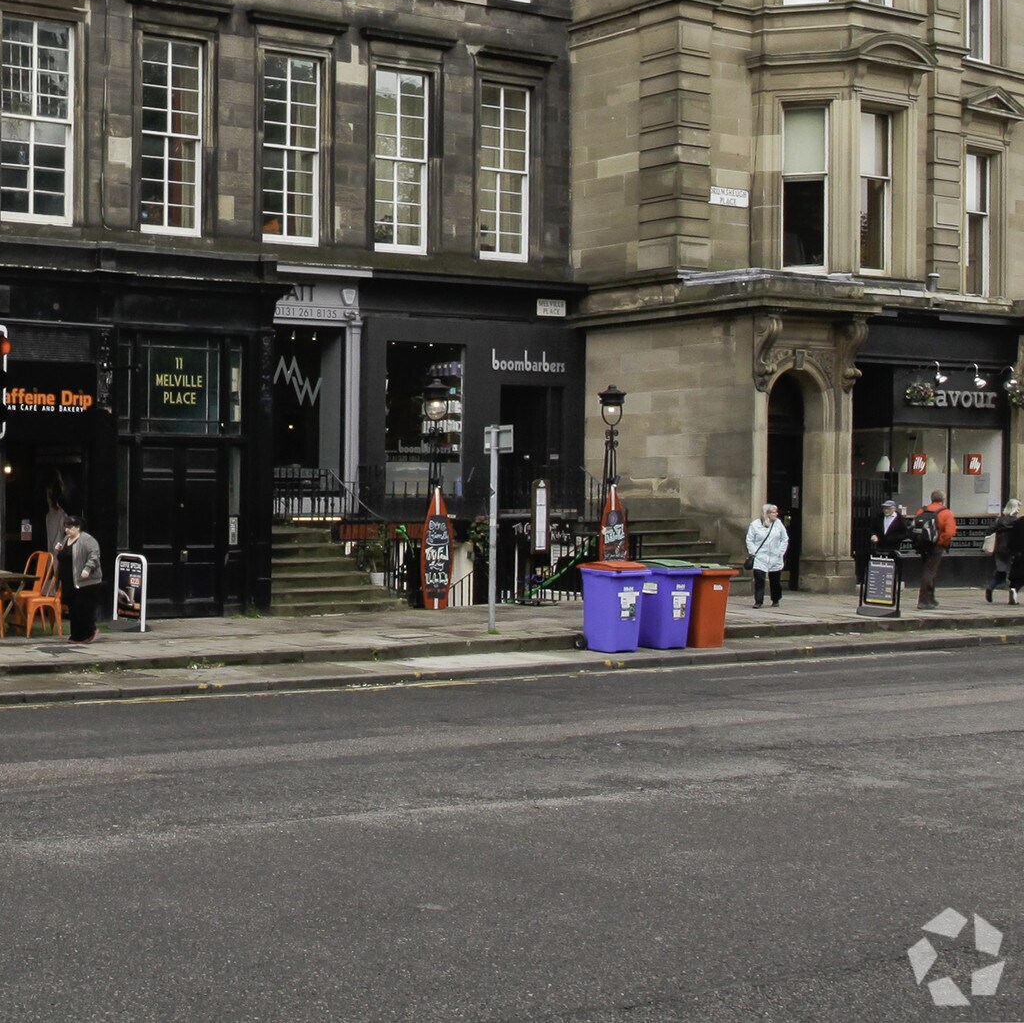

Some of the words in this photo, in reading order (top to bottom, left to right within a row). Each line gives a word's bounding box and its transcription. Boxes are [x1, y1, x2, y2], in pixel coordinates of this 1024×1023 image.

[720, 197, 736, 205] PLACE
[285, 284, 315, 302] ATT
[275, 307, 295, 316] 0131
[299, 308, 313, 317] 261
[316, 309, 337, 318] 8135
[175, 357, 183, 370] 11
[492, 348, 565, 373] boombarbers
[156, 374, 203, 387] MELVILLE
[5, 387, 55, 405] affeine
[62, 389, 92, 410] Drip
[163, 391, 196, 404] PLACE
[935, 389, 997, 408] avour
[913, 456, 926, 472] illy
[969, 457, 981, 472] illy
